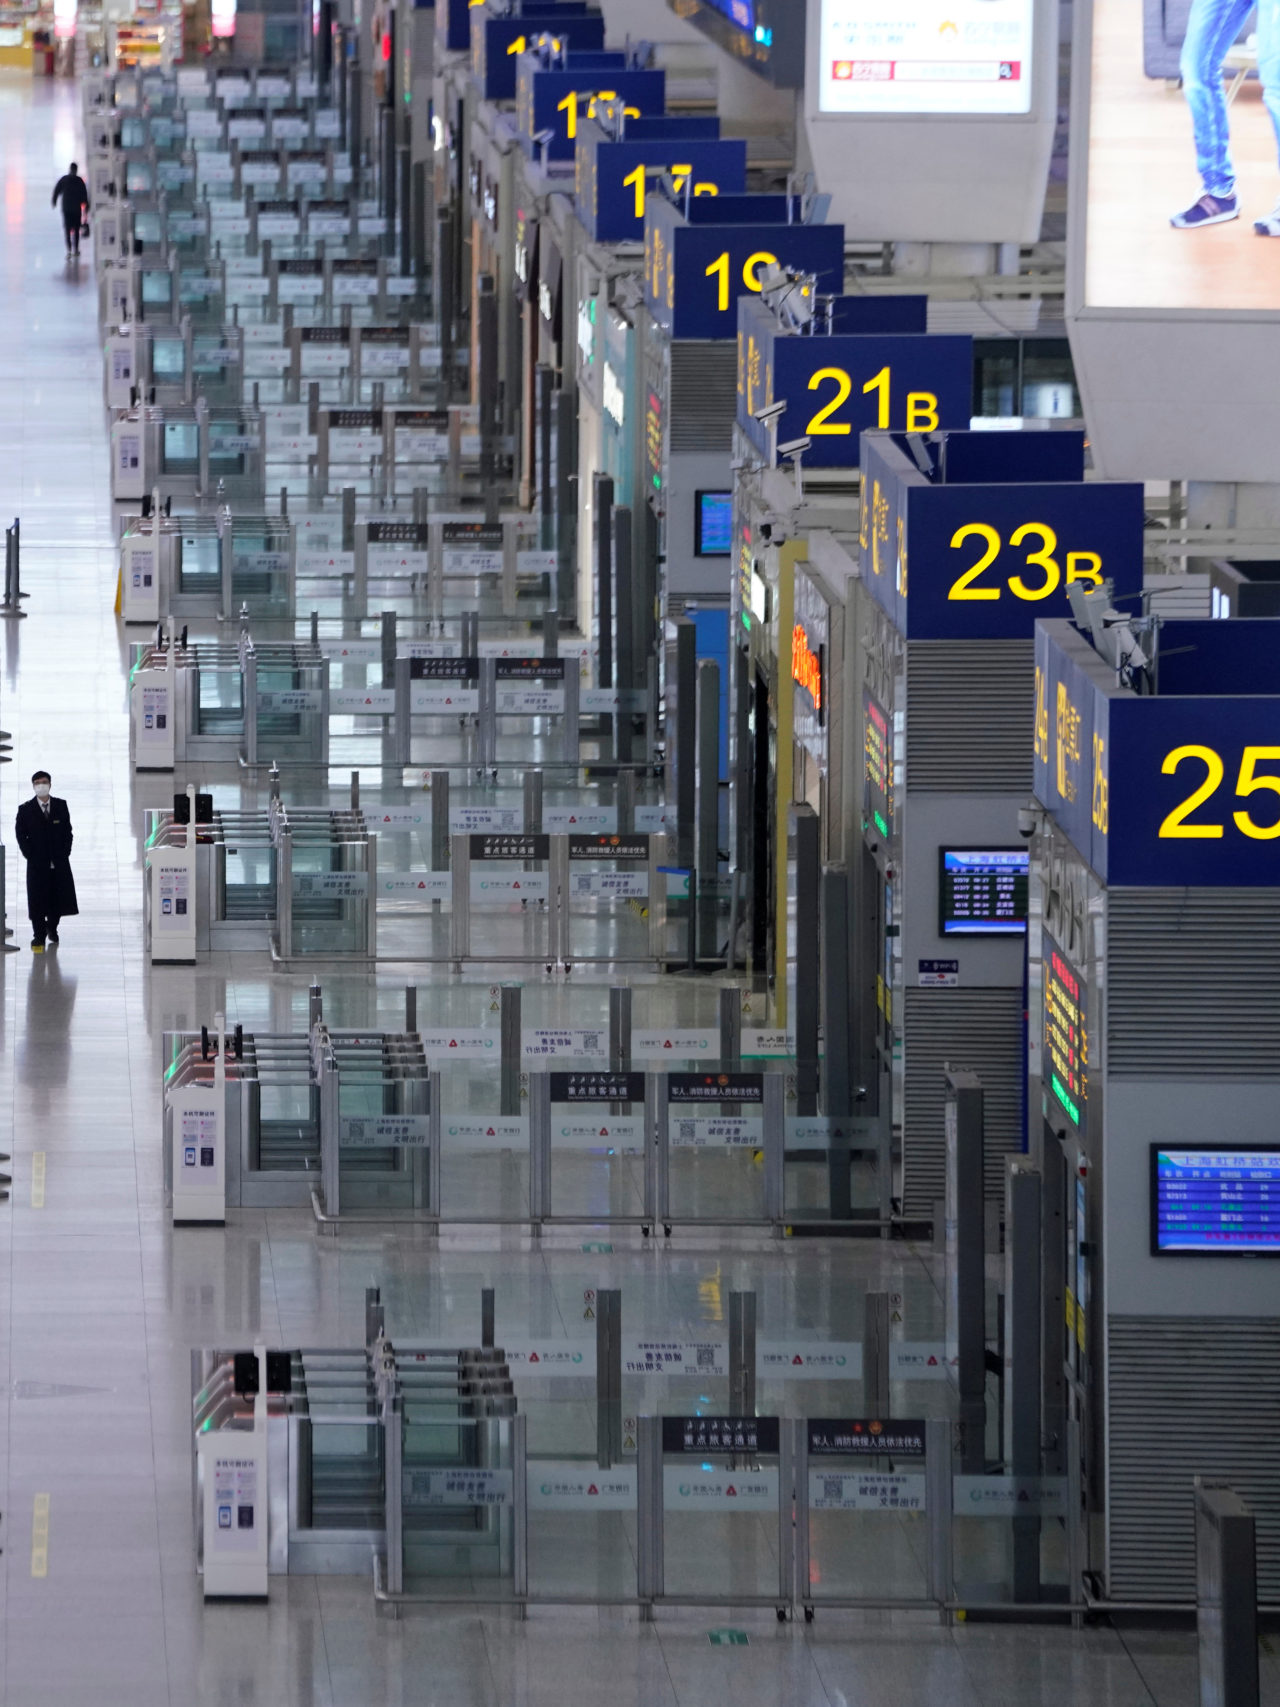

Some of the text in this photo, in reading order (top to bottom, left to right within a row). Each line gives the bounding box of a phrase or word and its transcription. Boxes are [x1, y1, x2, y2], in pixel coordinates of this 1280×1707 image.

[805, 366, 940, 434] 21B
[683, 1434, 758, 1446] 重点旅客通道
[812, 1436, 923, 1448] 军人、消防救援人员依法优先
